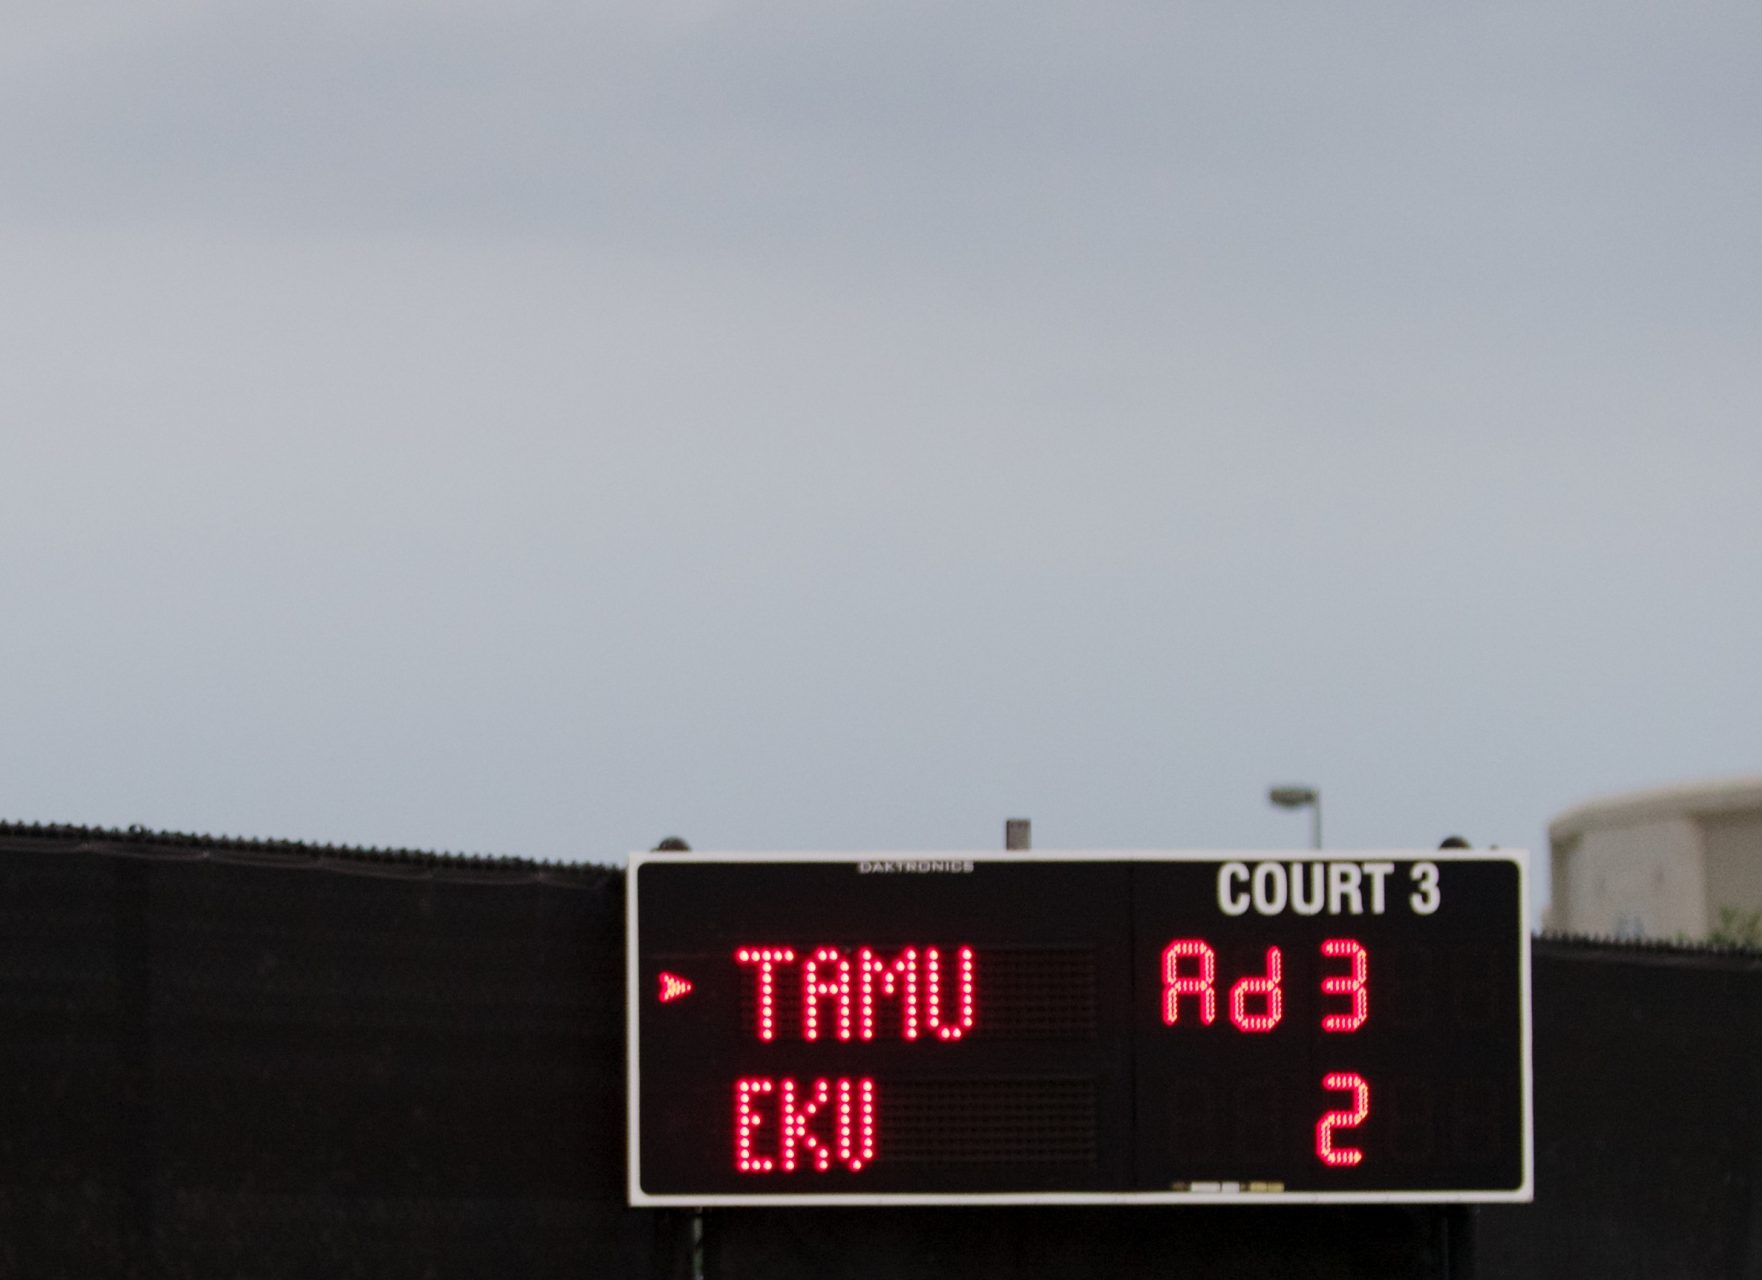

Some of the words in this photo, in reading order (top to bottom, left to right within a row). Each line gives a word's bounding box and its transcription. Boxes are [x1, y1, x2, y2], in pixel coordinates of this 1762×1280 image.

[858, 860, 975, 873] DAKTRONICS
[1217, 862, 1395, 915] COURT
[1410, 862, 1441, 915] 3
[735, 946, 977, 1041] TAMU
[1162, 939, 1283, 1032] Ad
[1321, 939, 1369, 1032] 3
[735, 1076, 877, 1173] EKU
[1316, 1073, 1369, 1166] 2
